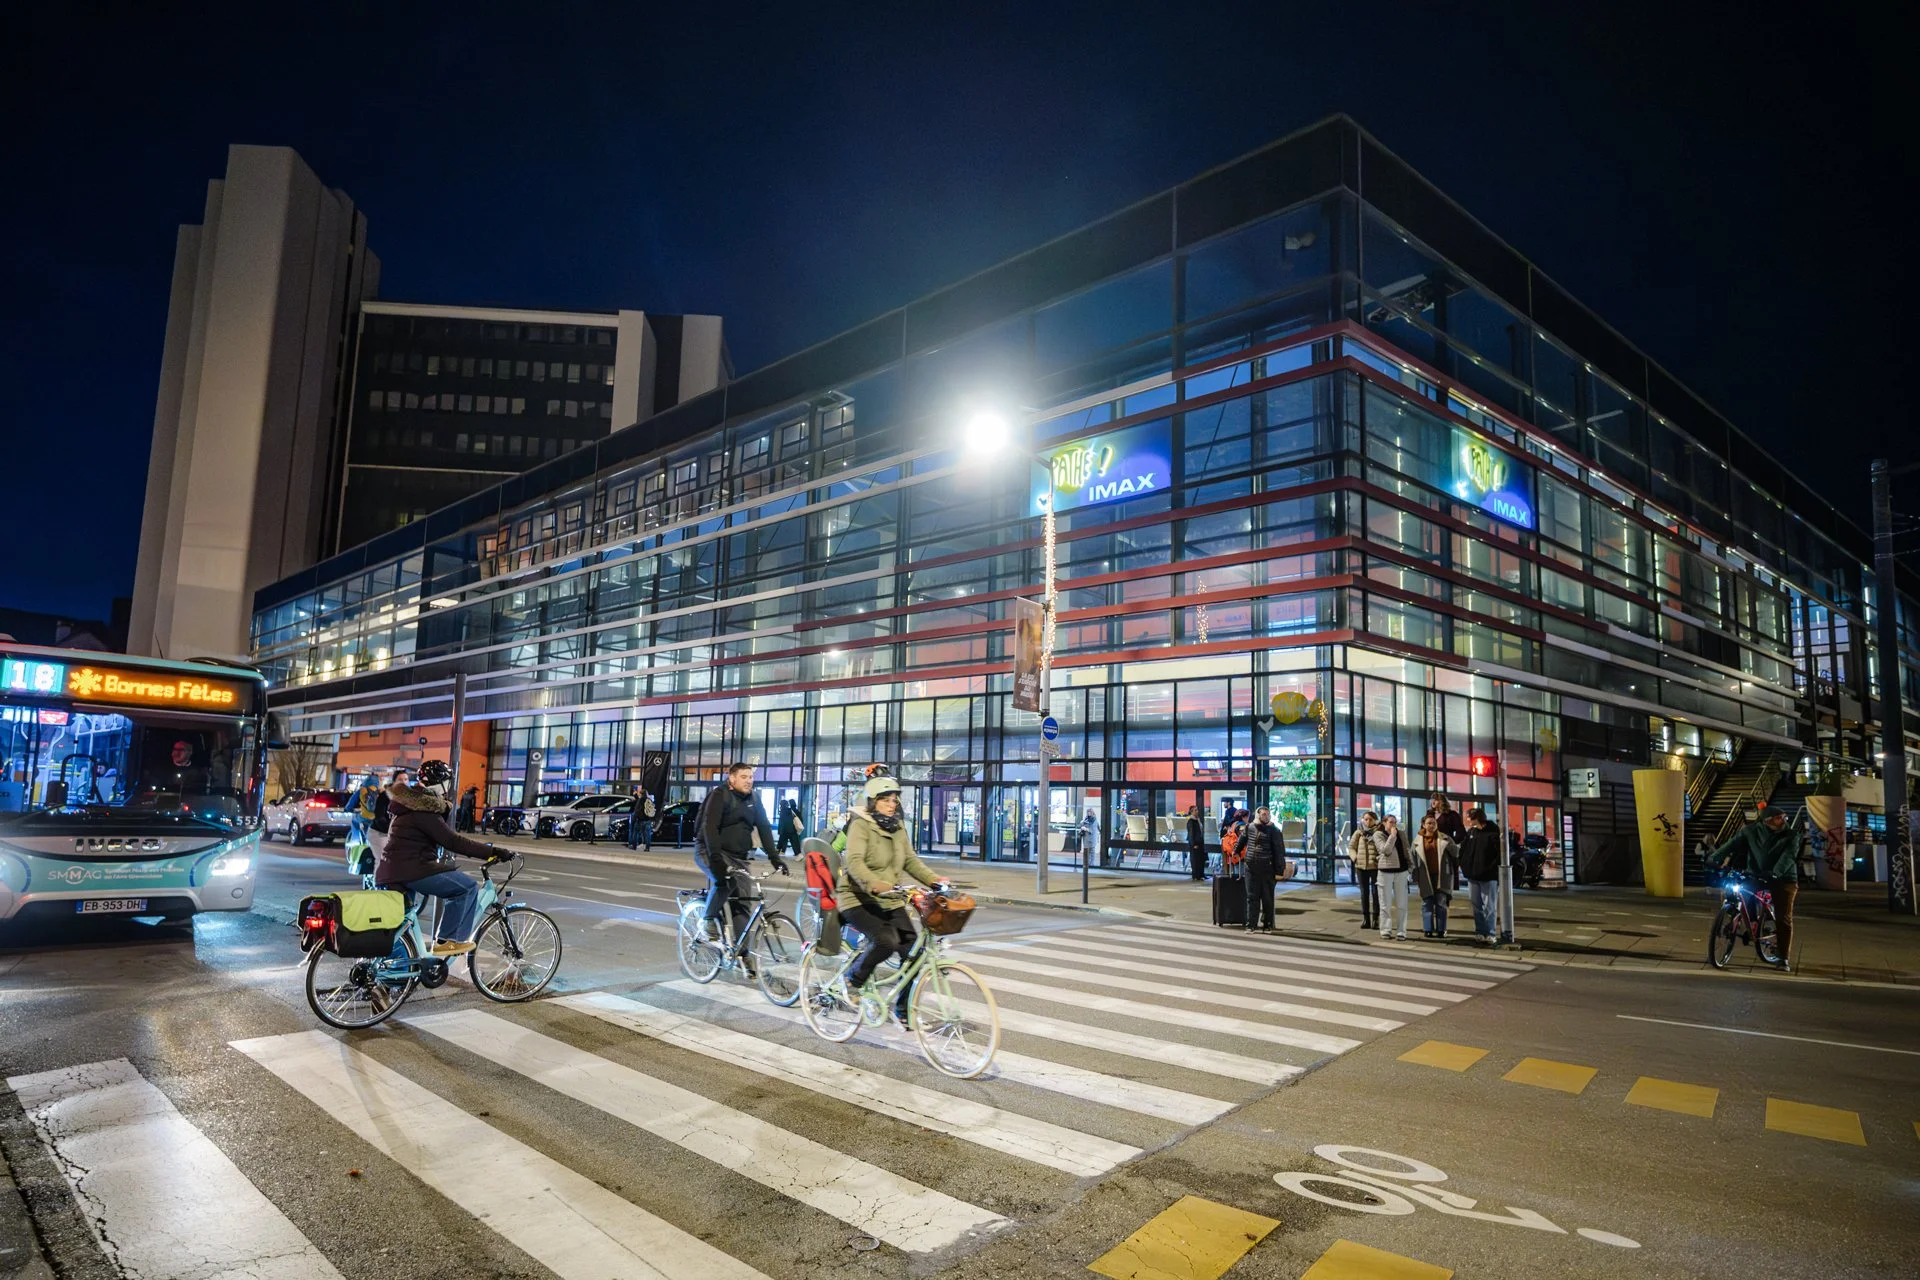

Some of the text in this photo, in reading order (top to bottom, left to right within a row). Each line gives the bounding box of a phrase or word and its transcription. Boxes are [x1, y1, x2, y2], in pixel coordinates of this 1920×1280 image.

[1089, 473, 1156, 501] IMAX
[1494, 499, 1527, 524] IMAX
[10, 662, 55, 690] 18
[104, 676, 176, 699] Bonnes
[1587, 772, 1595, 781] P
[236, 816, 258, 826] 553
[75, 838, 161, 852] IVECO
[47, 867, 102, 882] SMMAG
[84, 900, 141, 911] EB-953-DH
